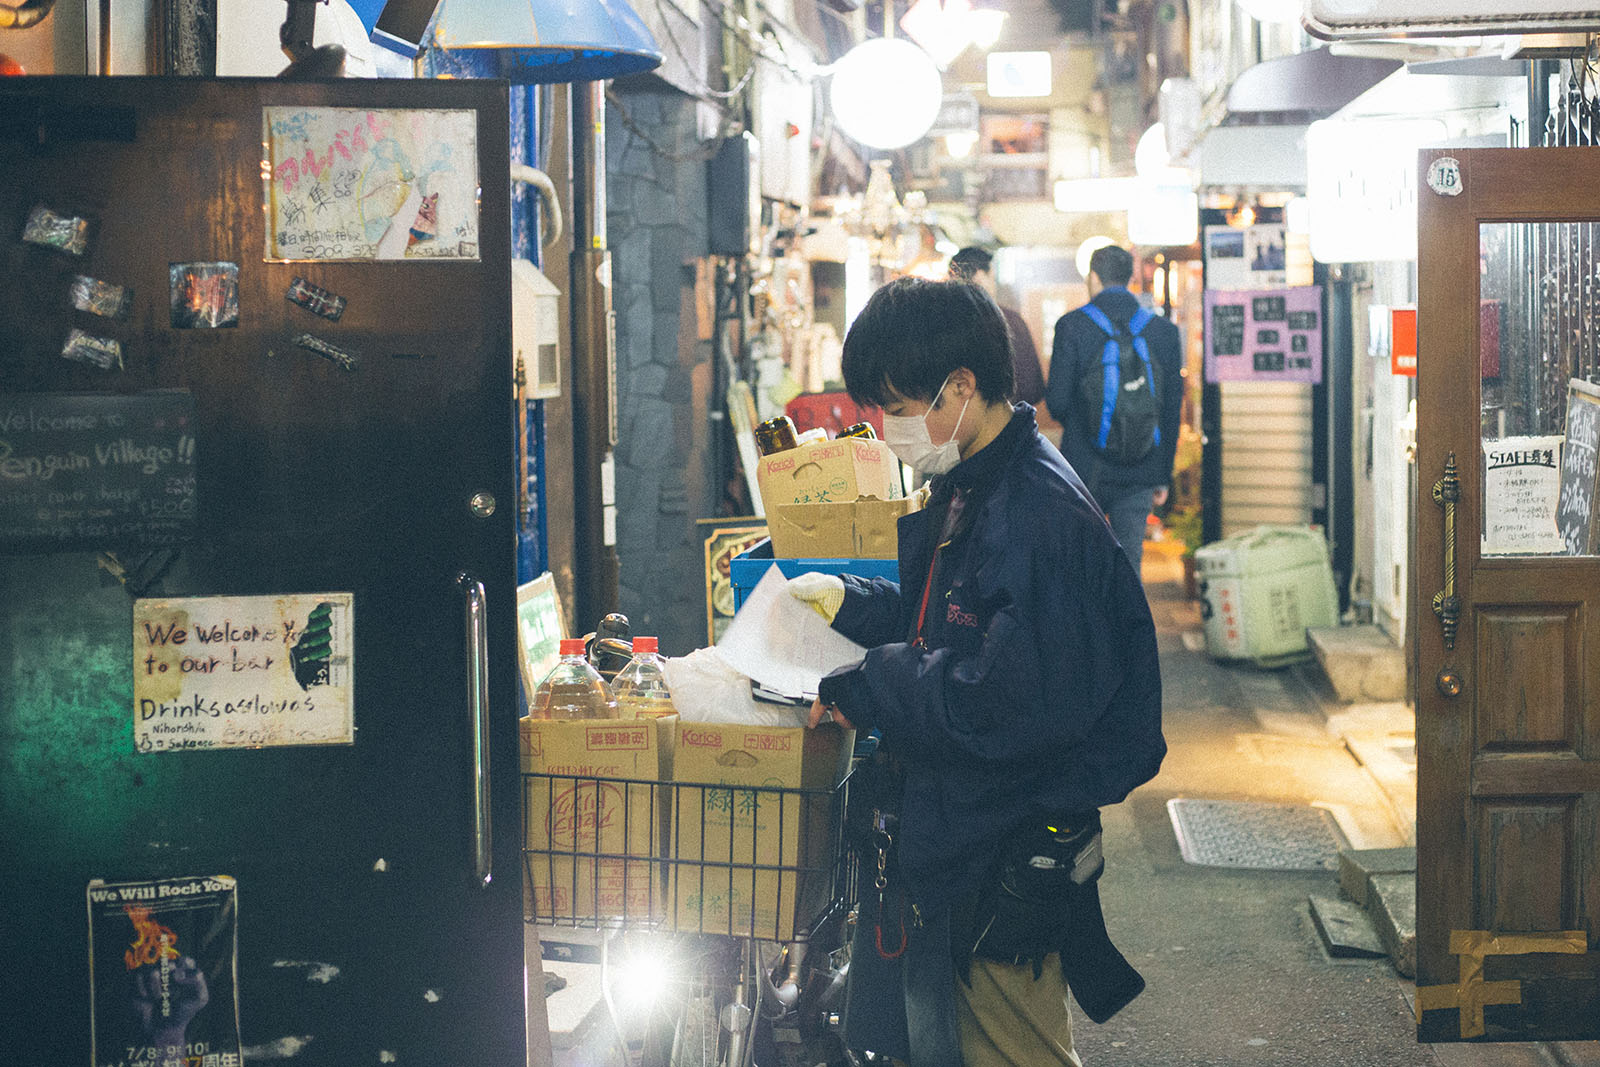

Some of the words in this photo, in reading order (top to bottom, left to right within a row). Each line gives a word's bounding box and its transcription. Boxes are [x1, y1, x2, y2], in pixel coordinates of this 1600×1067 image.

[1437, 167, 1457, 188] 15
[143, 621, 188, 645] We
[145, 653, 169, 676] to
[180, 657, 219, 675] our
[231, 647, 274, 673] bar
[140, 693, 221, 721] Drinks
[91, 890, 118, 903] We
[119, 886, 156, 901] Will
[158, 881, 201, 897] Rock
[202, 880, 235, 892] You
